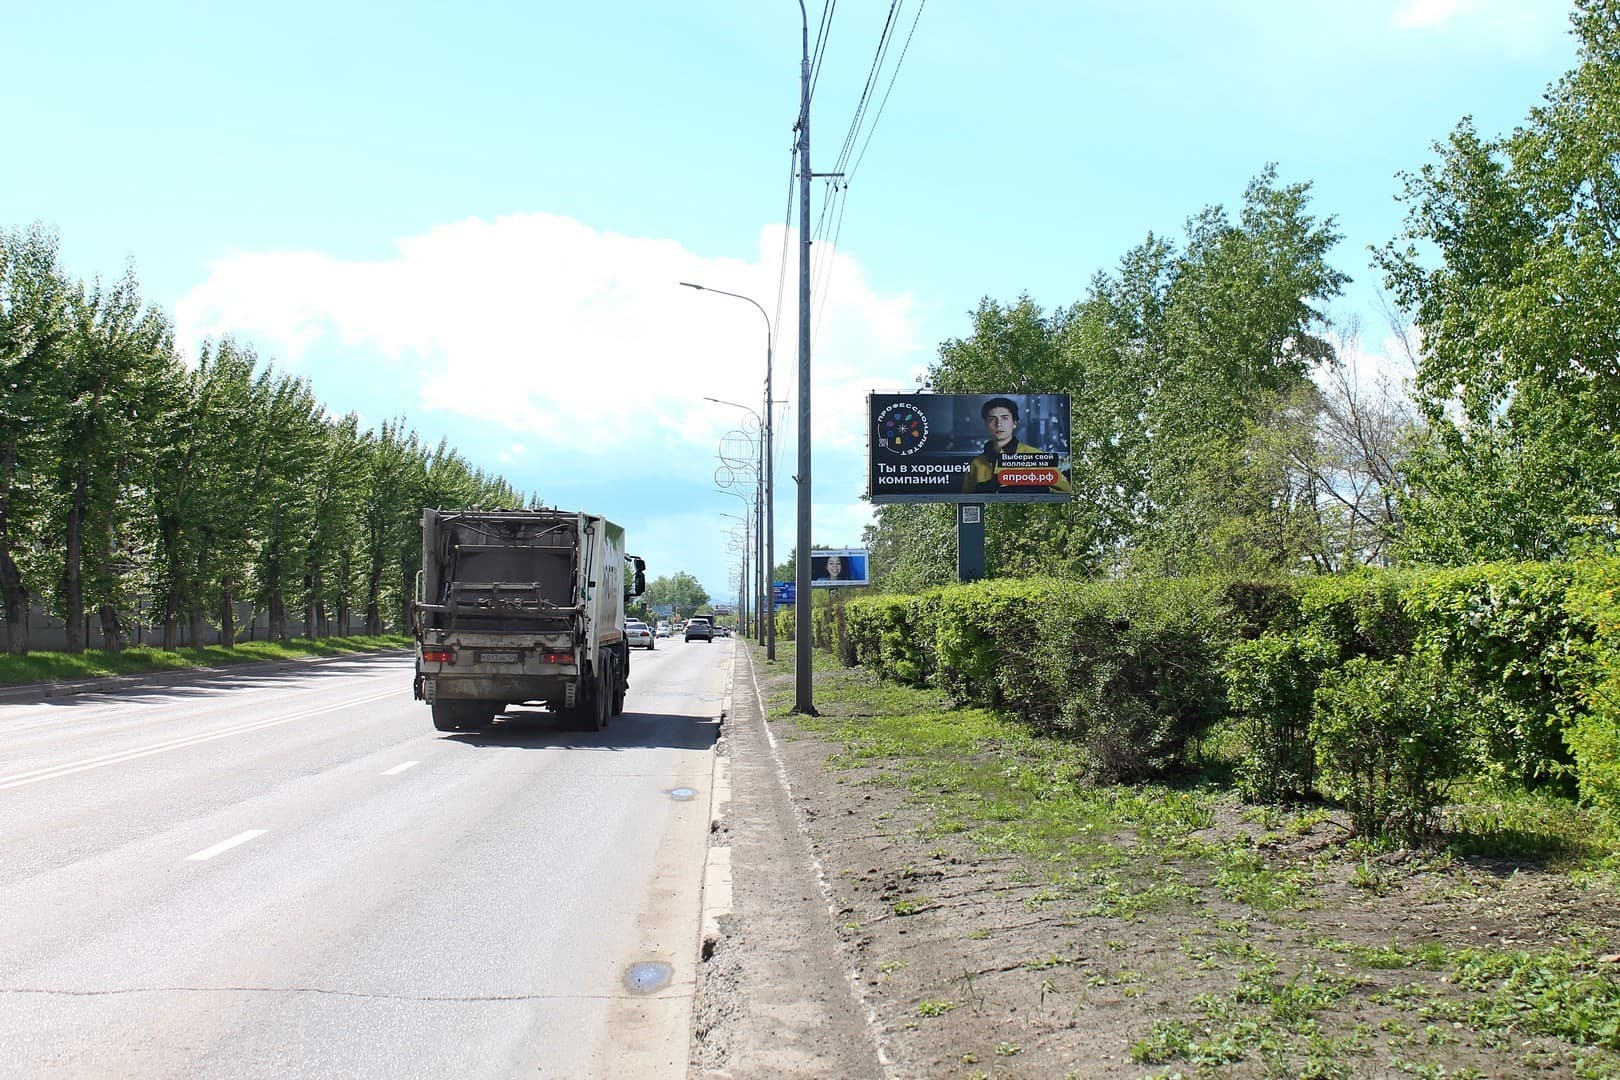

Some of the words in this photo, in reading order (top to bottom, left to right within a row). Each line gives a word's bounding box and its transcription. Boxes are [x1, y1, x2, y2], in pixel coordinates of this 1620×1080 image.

[877, 402, 929, 456] ПРОФЕССИОНАЛИТЕТ
[877, 463, 896, 473] Ты
[900, 465, 907, 473] в
[911, 462, 971, 475] хорошей
[878, 474, 949, 485] компании!
[1002, 472, 1054, 482] япроф.рф
